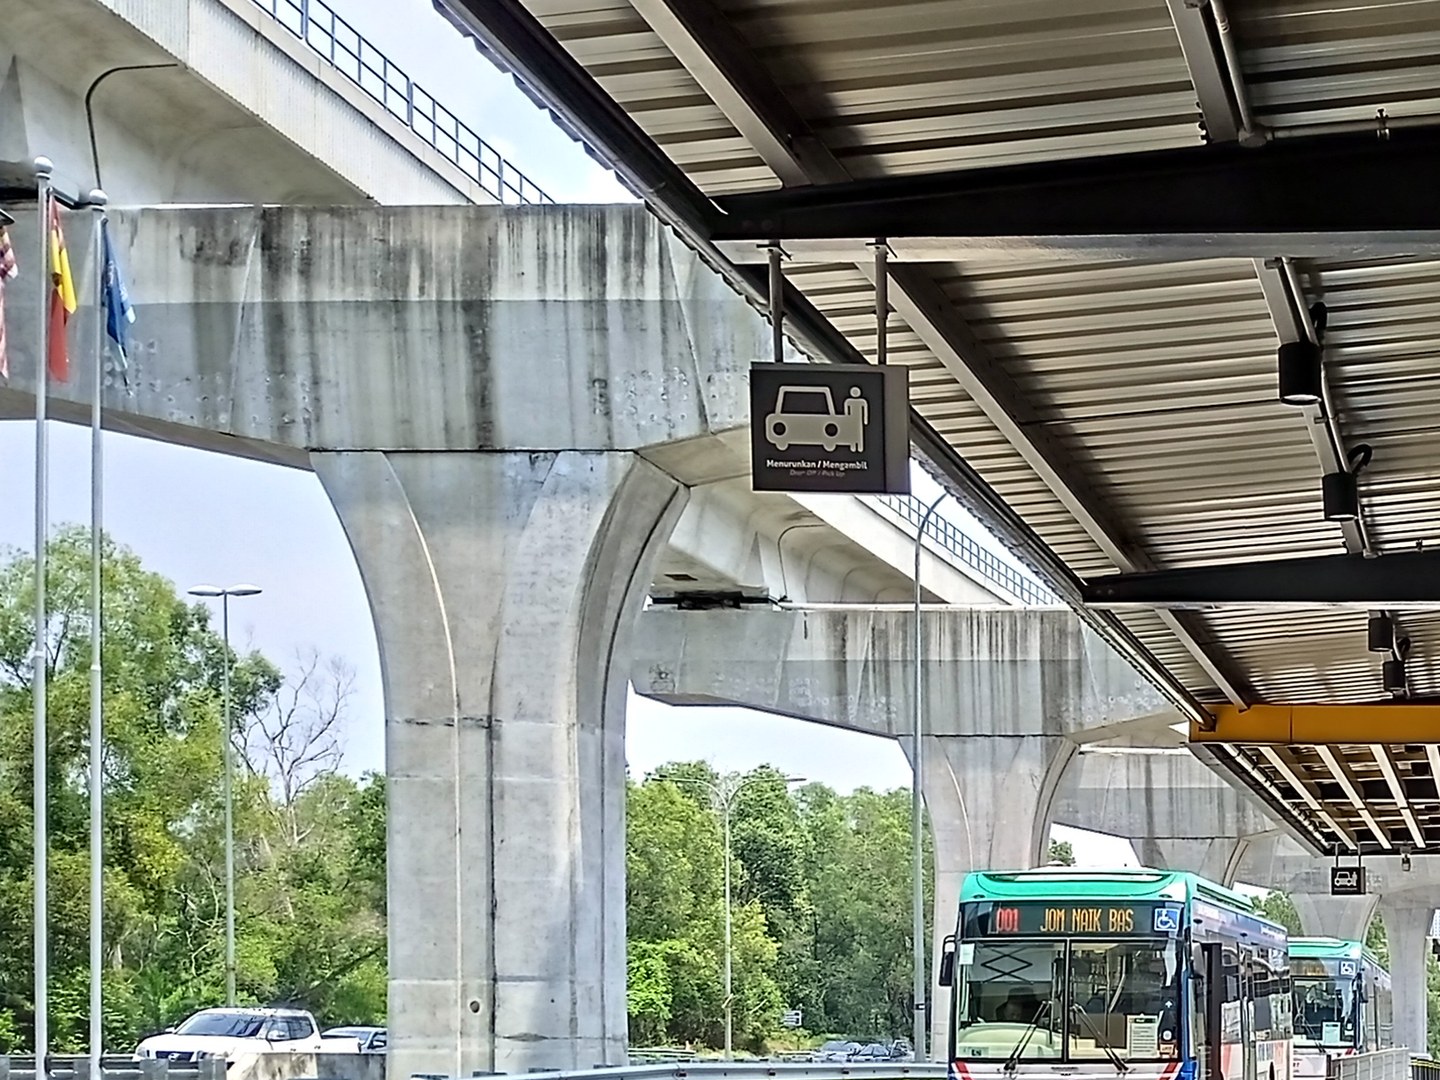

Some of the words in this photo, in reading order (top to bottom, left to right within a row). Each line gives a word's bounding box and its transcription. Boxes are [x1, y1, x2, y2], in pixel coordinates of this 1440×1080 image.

[766, 459, 816, 468] Menurunkan
[822, 460, 868, 471] Mengambil
[996, 908, 1018, 931] 001
[1040, 908, 1065, 931] JOM
[1072, 908, 1102, 931] NAIK
[1109, 908, 1134, 931] BAS
